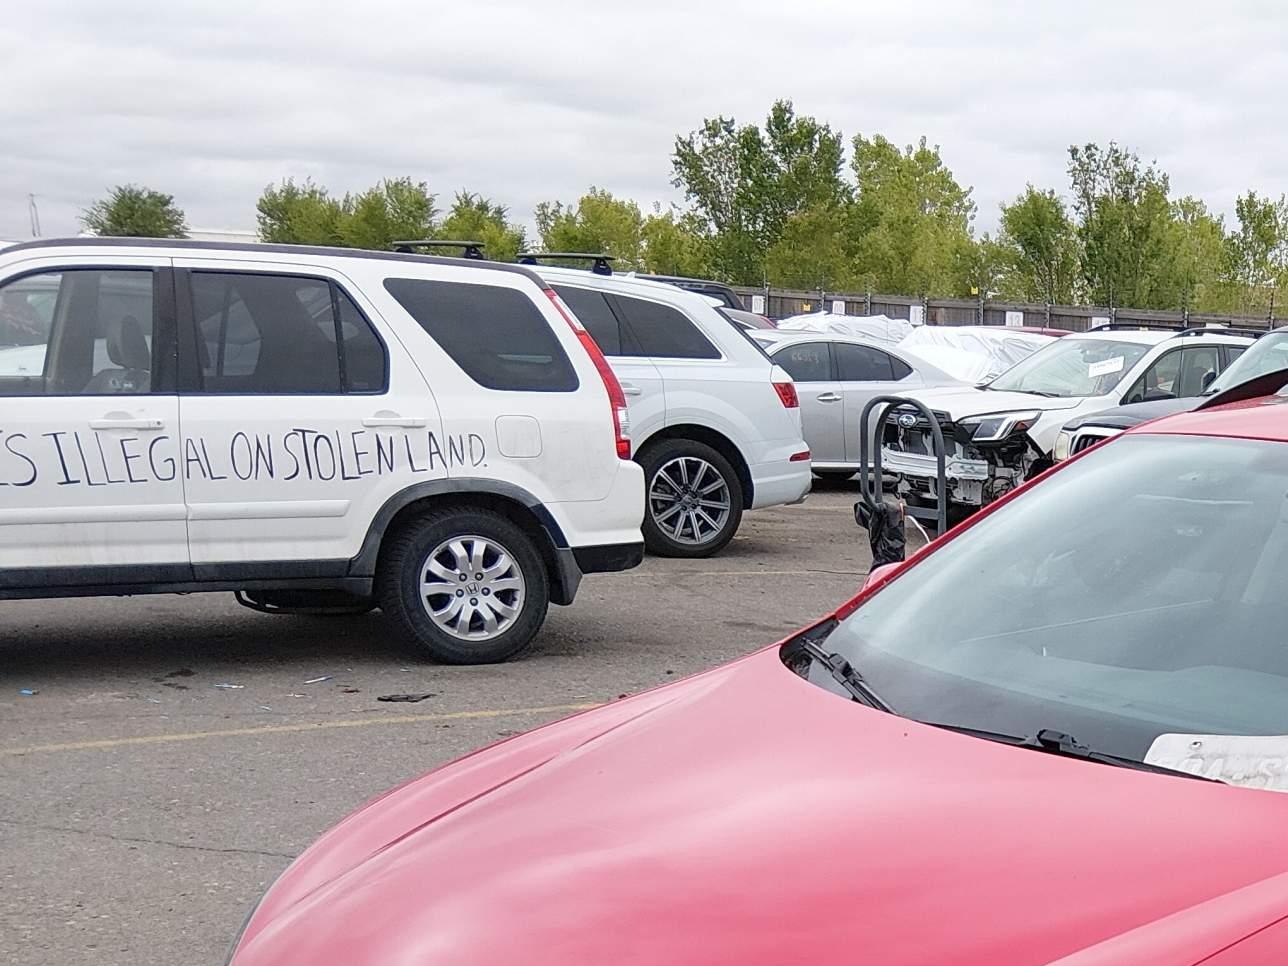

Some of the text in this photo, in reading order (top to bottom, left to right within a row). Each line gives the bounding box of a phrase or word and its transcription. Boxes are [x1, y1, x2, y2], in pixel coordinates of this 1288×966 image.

[42, 429, 228, 487] ILLEGAL
[230, 431, 274, 480] ON
[283, 428, 395, 480] STOLEN
[406, 431, 489, 473] LAND.
